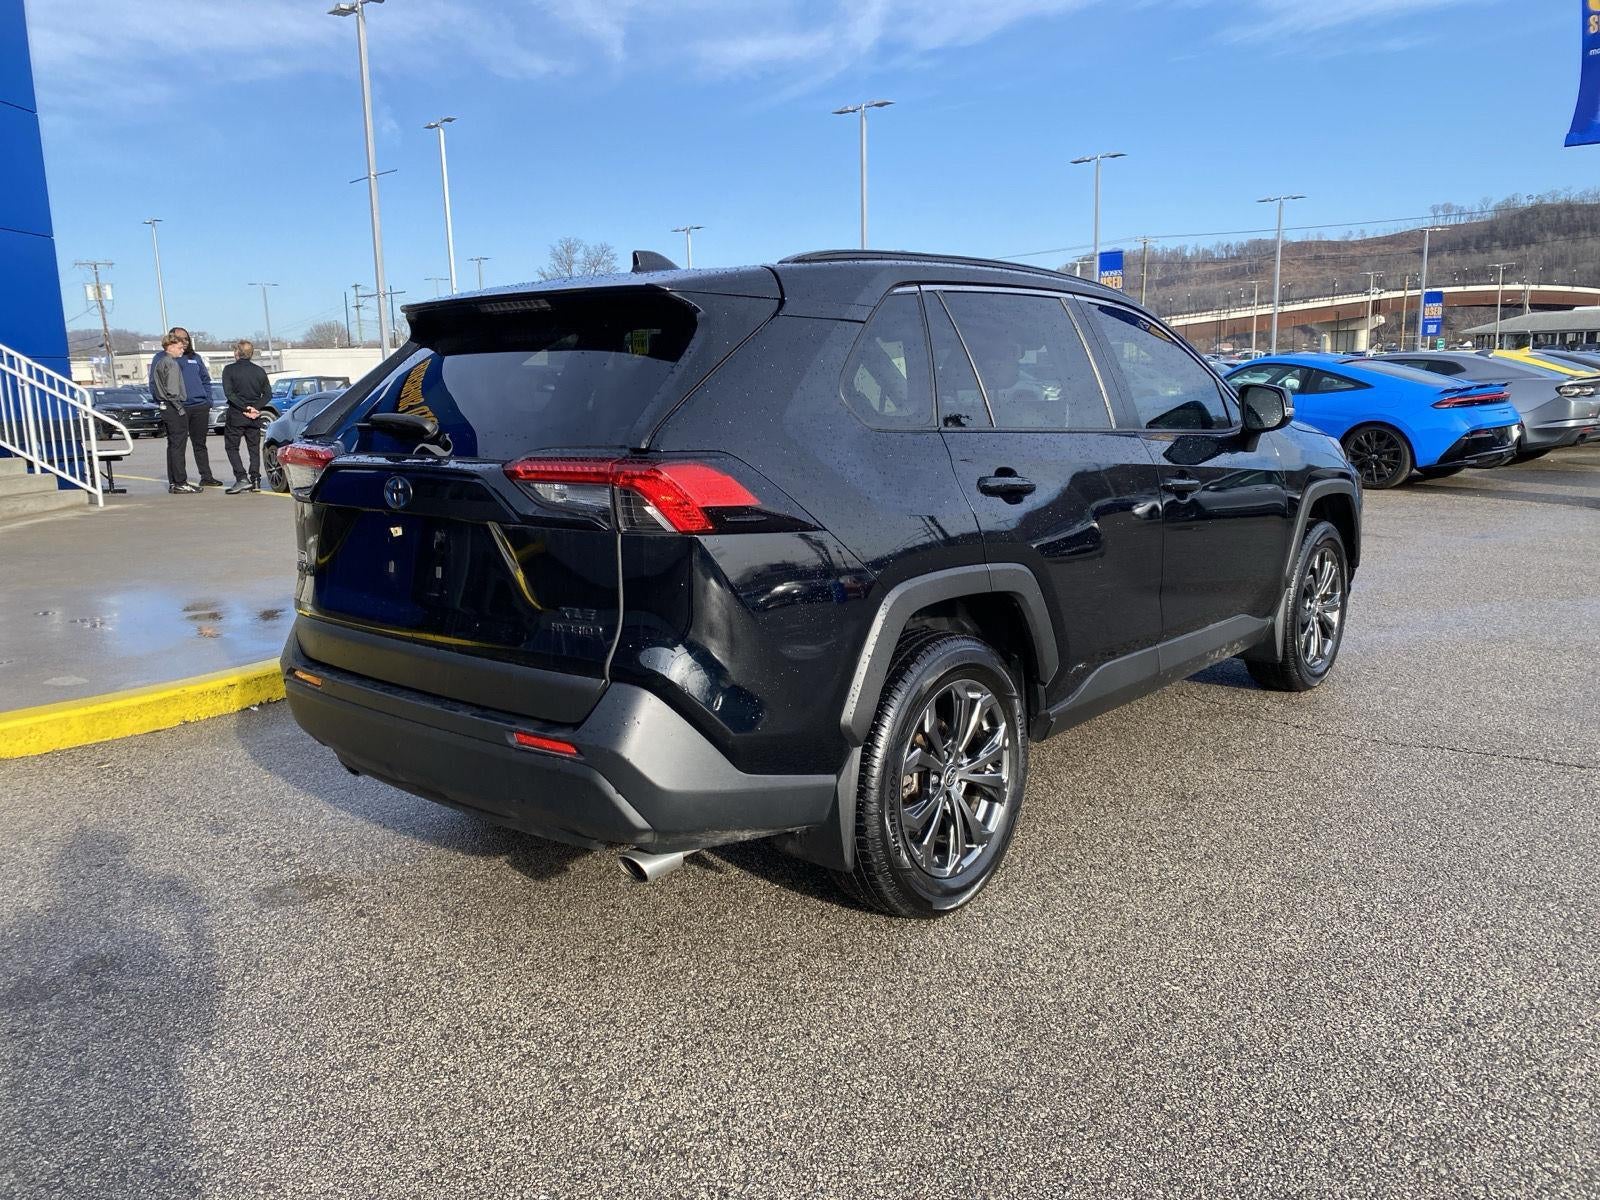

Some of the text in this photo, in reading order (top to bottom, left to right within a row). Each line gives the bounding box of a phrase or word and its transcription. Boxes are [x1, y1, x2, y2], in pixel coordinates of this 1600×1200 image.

[1100, 269, 1123, 277] MOSES
[1100, 275, 1123, 289] USED
[1424, 306, 1442, 316] USED
